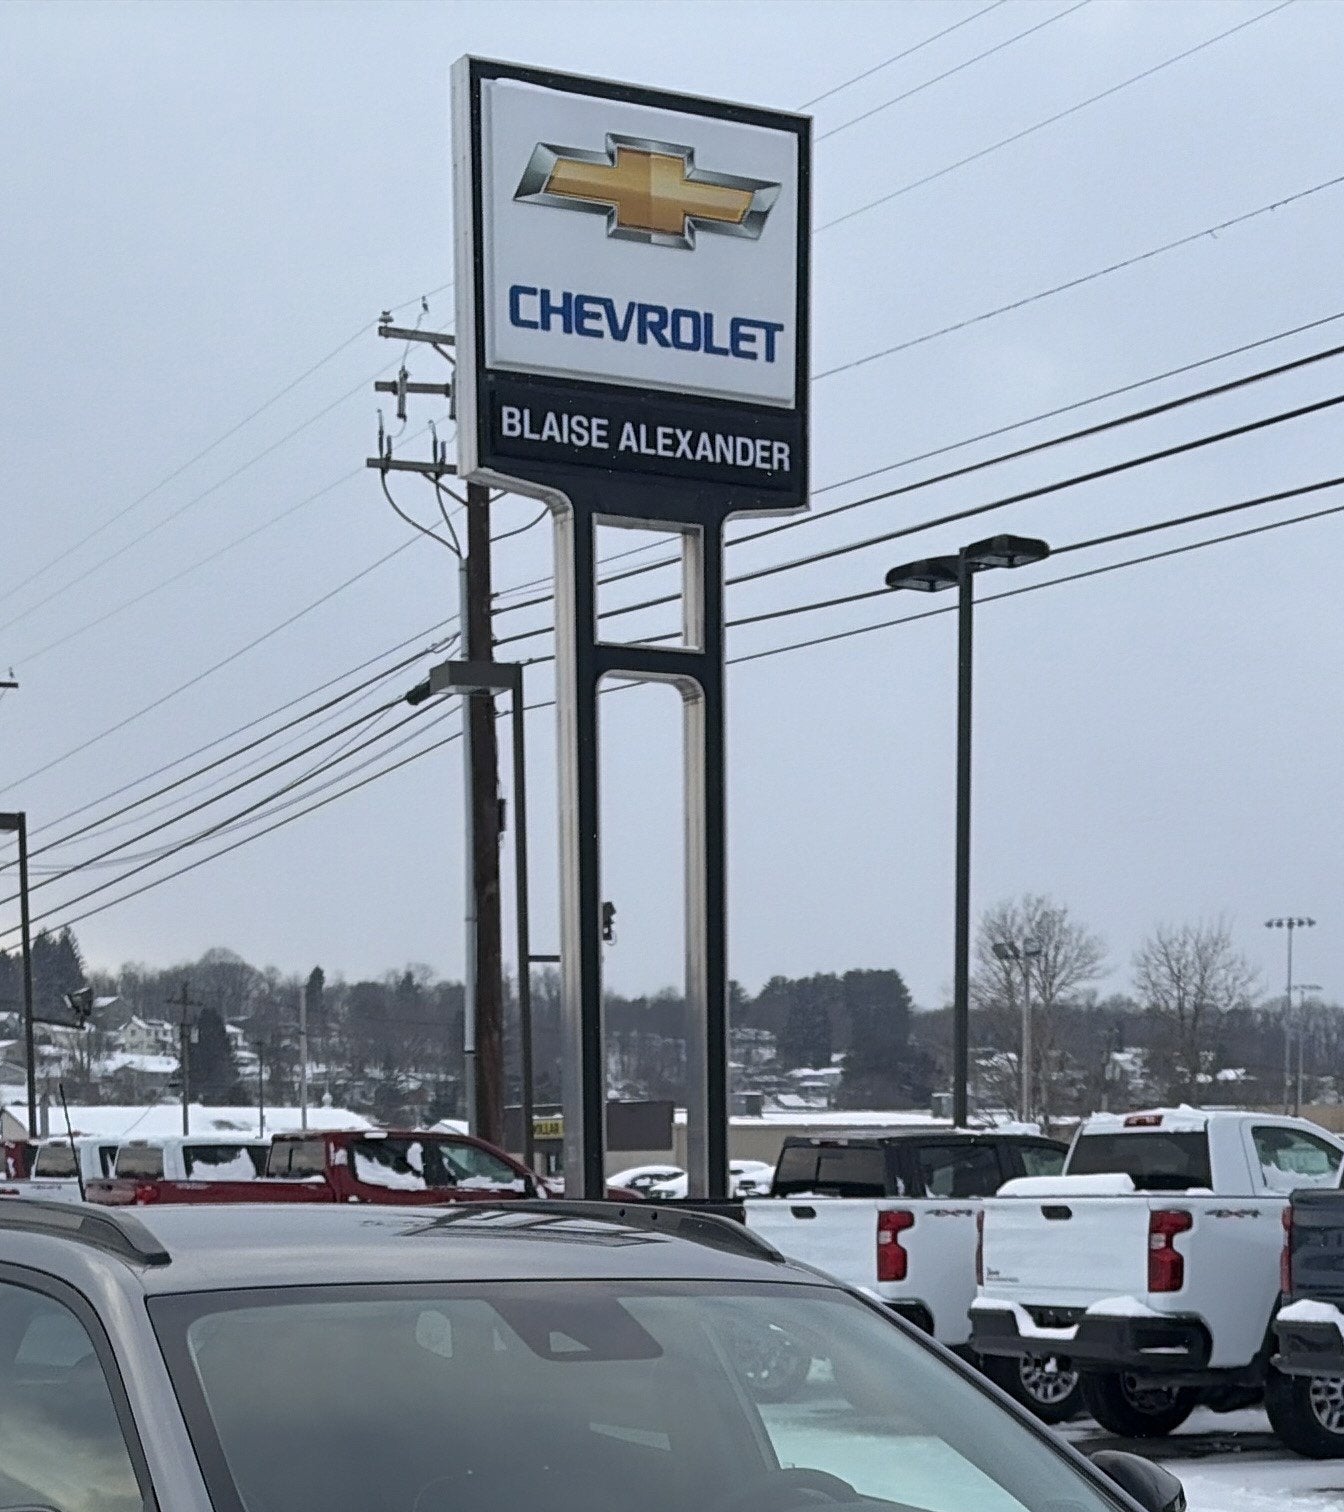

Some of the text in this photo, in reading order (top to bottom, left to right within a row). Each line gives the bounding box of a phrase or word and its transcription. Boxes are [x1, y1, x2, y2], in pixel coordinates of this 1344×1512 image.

[508, 284, 785, 364] CHEVROLET
[501, 405, 791, 472] BLAISE ALEXANDER
